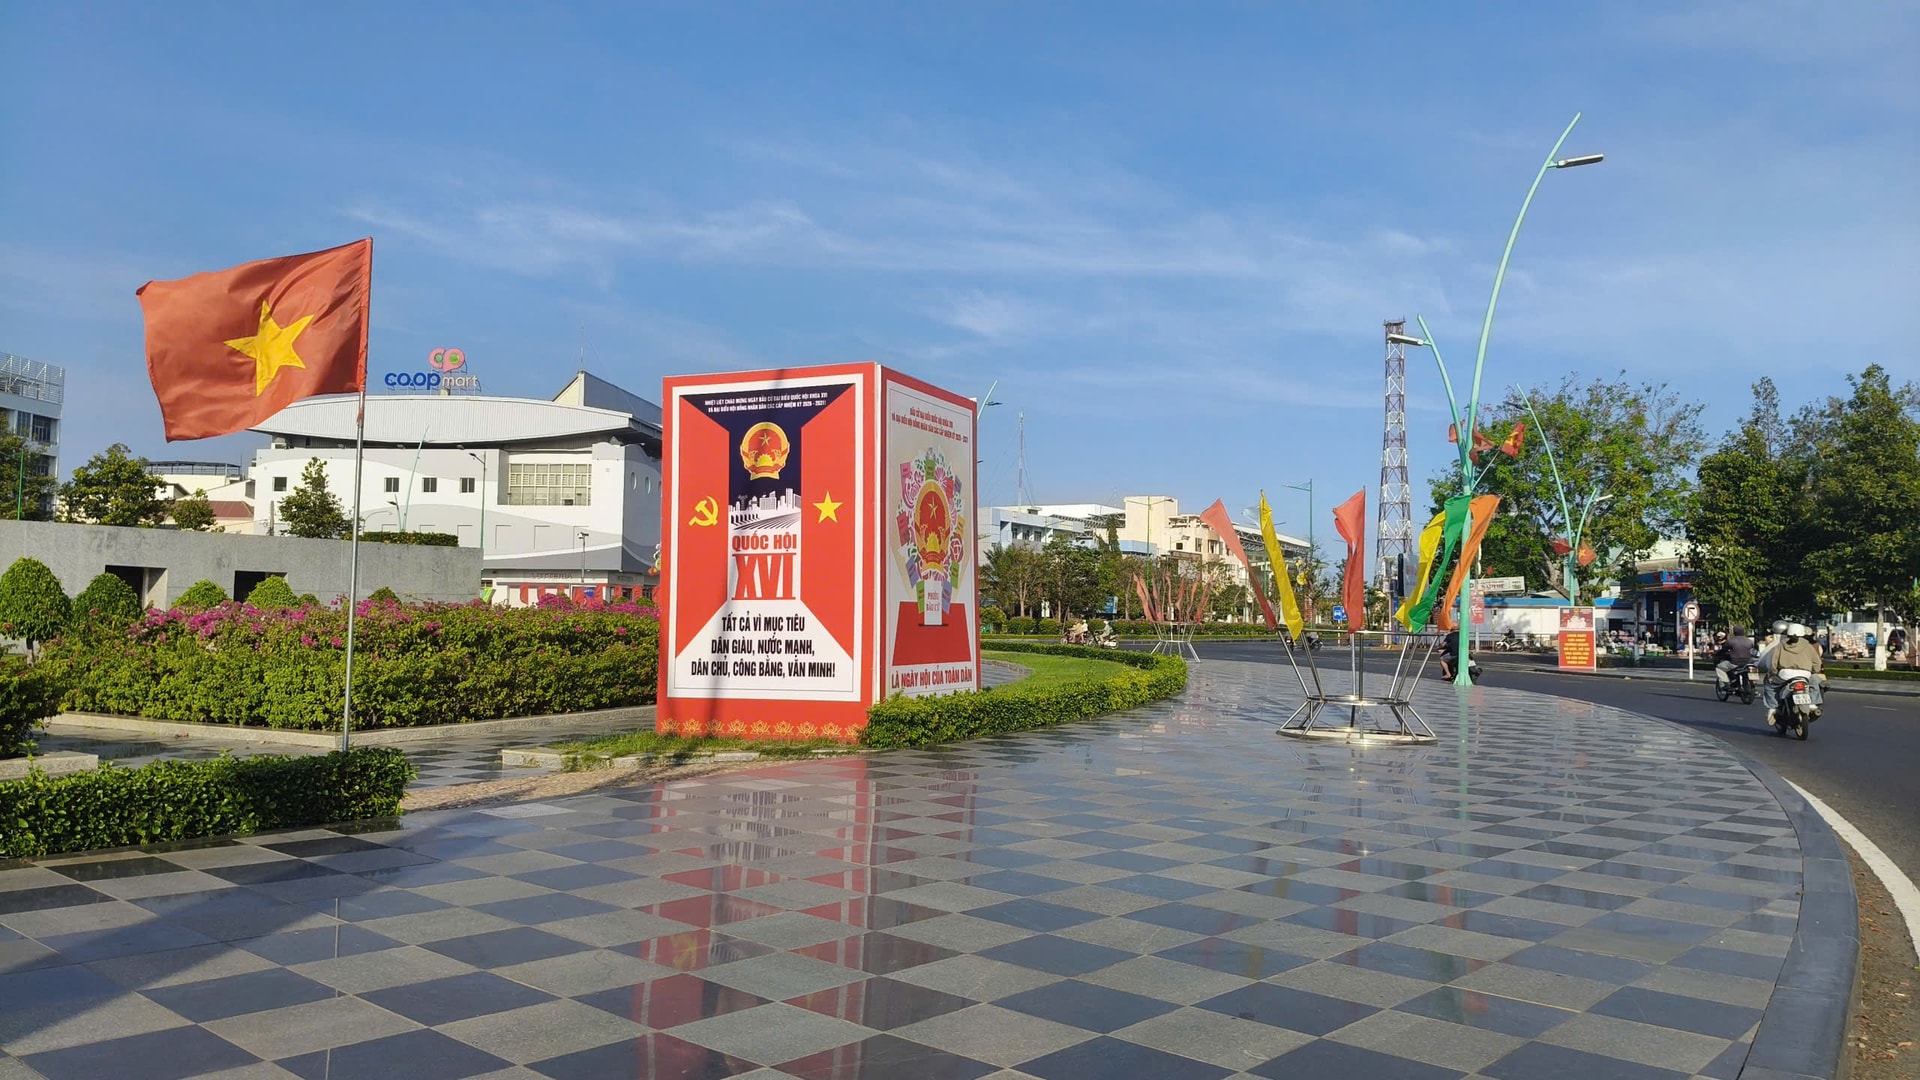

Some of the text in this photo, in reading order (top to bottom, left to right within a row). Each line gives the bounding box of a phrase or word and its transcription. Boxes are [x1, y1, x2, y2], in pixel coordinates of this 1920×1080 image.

[732, 530, 797, 552] QUỐC HỘI
[732, 553, 796, 600] XVI
[722, 611, 805, 634] TẤT CẢ VÌ MỤC TIÊU
[711, 634, 815, 657] DÂN GIÀU, NƯỚC MẠNH,
[691, 655, 835, 678] DÂN CHỦ, CÔNG BẰNG, VĂN MINH!
[892, 665, 972, 689] LÀ NGÀY HỘI CỦA TOÀN DÂN
